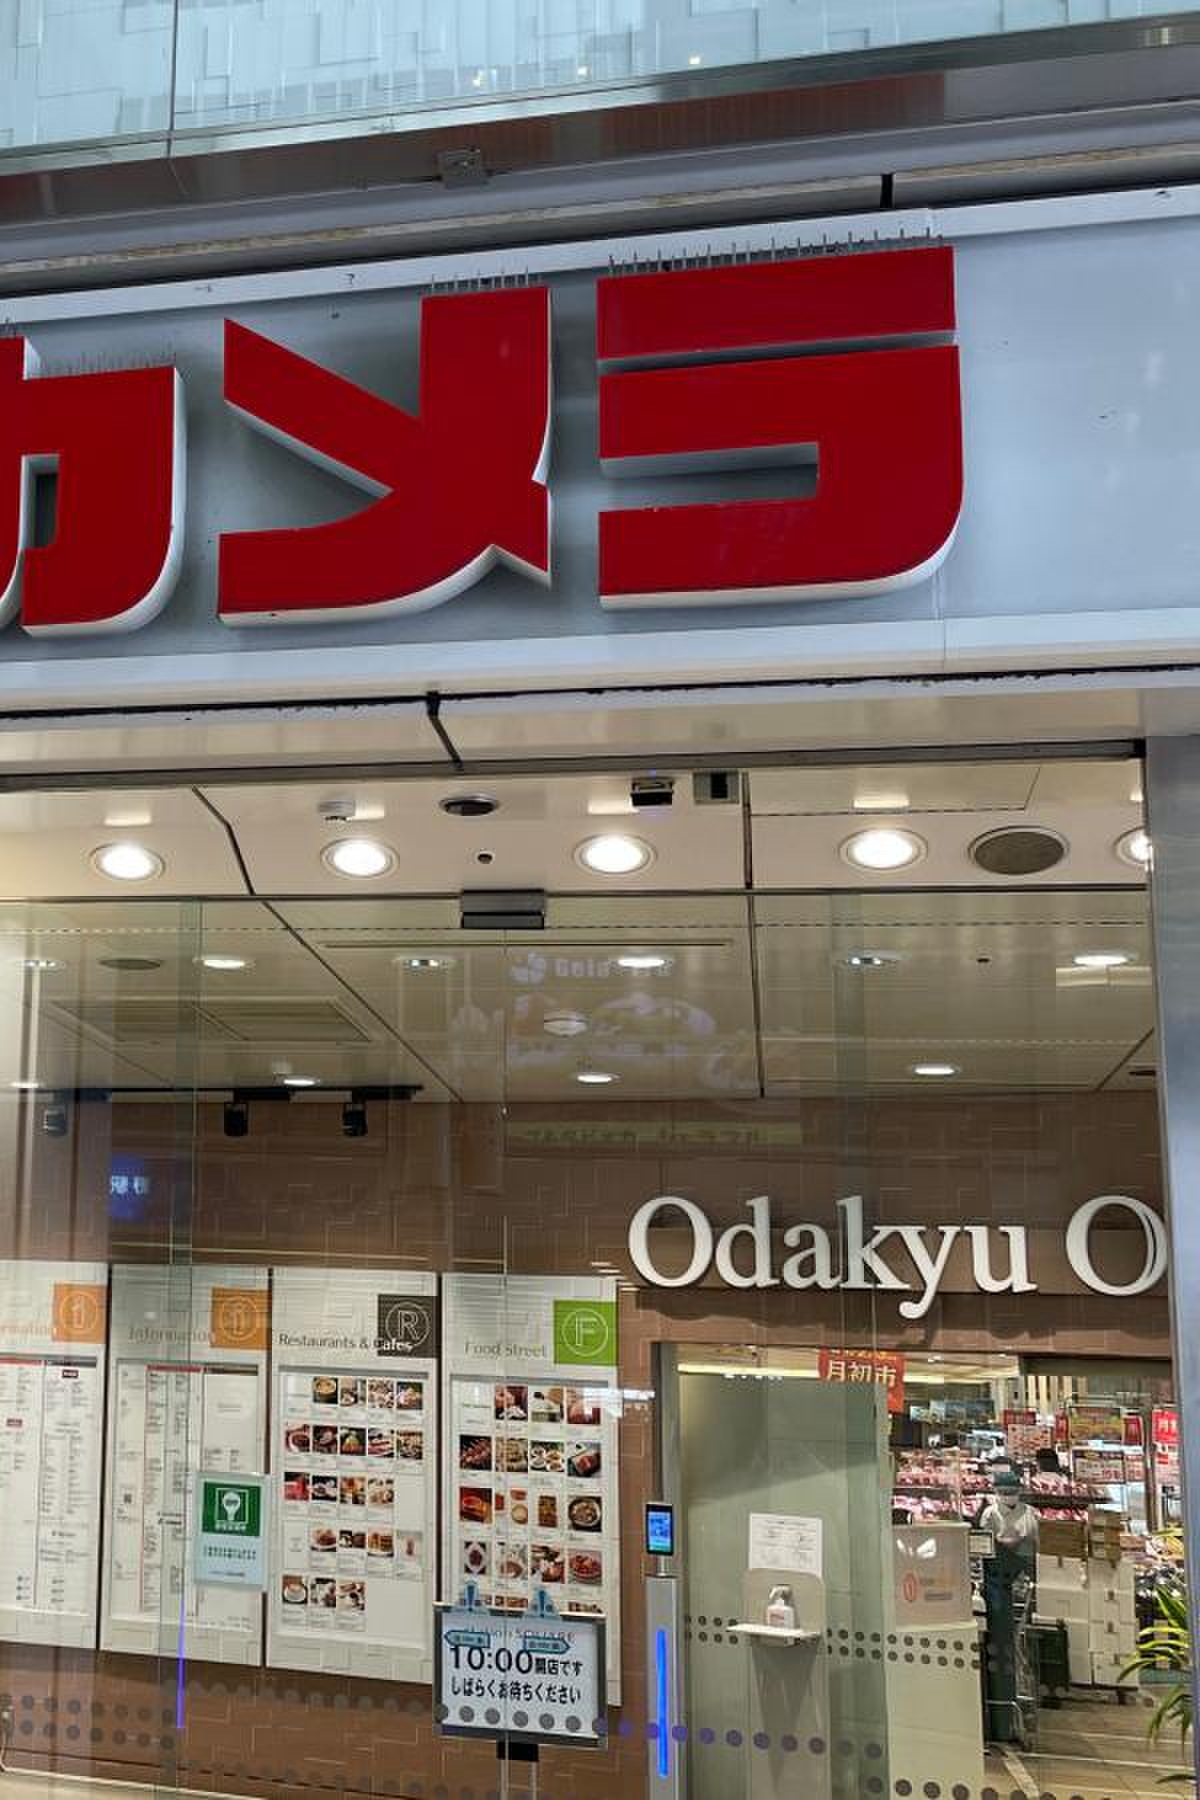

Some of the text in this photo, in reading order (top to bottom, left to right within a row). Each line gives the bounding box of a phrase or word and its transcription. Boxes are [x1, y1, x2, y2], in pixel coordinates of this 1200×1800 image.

[628, 1195, 1039, 1320] Odakyu
[451, 1677, 582, 1704] しばらくお待ちください
